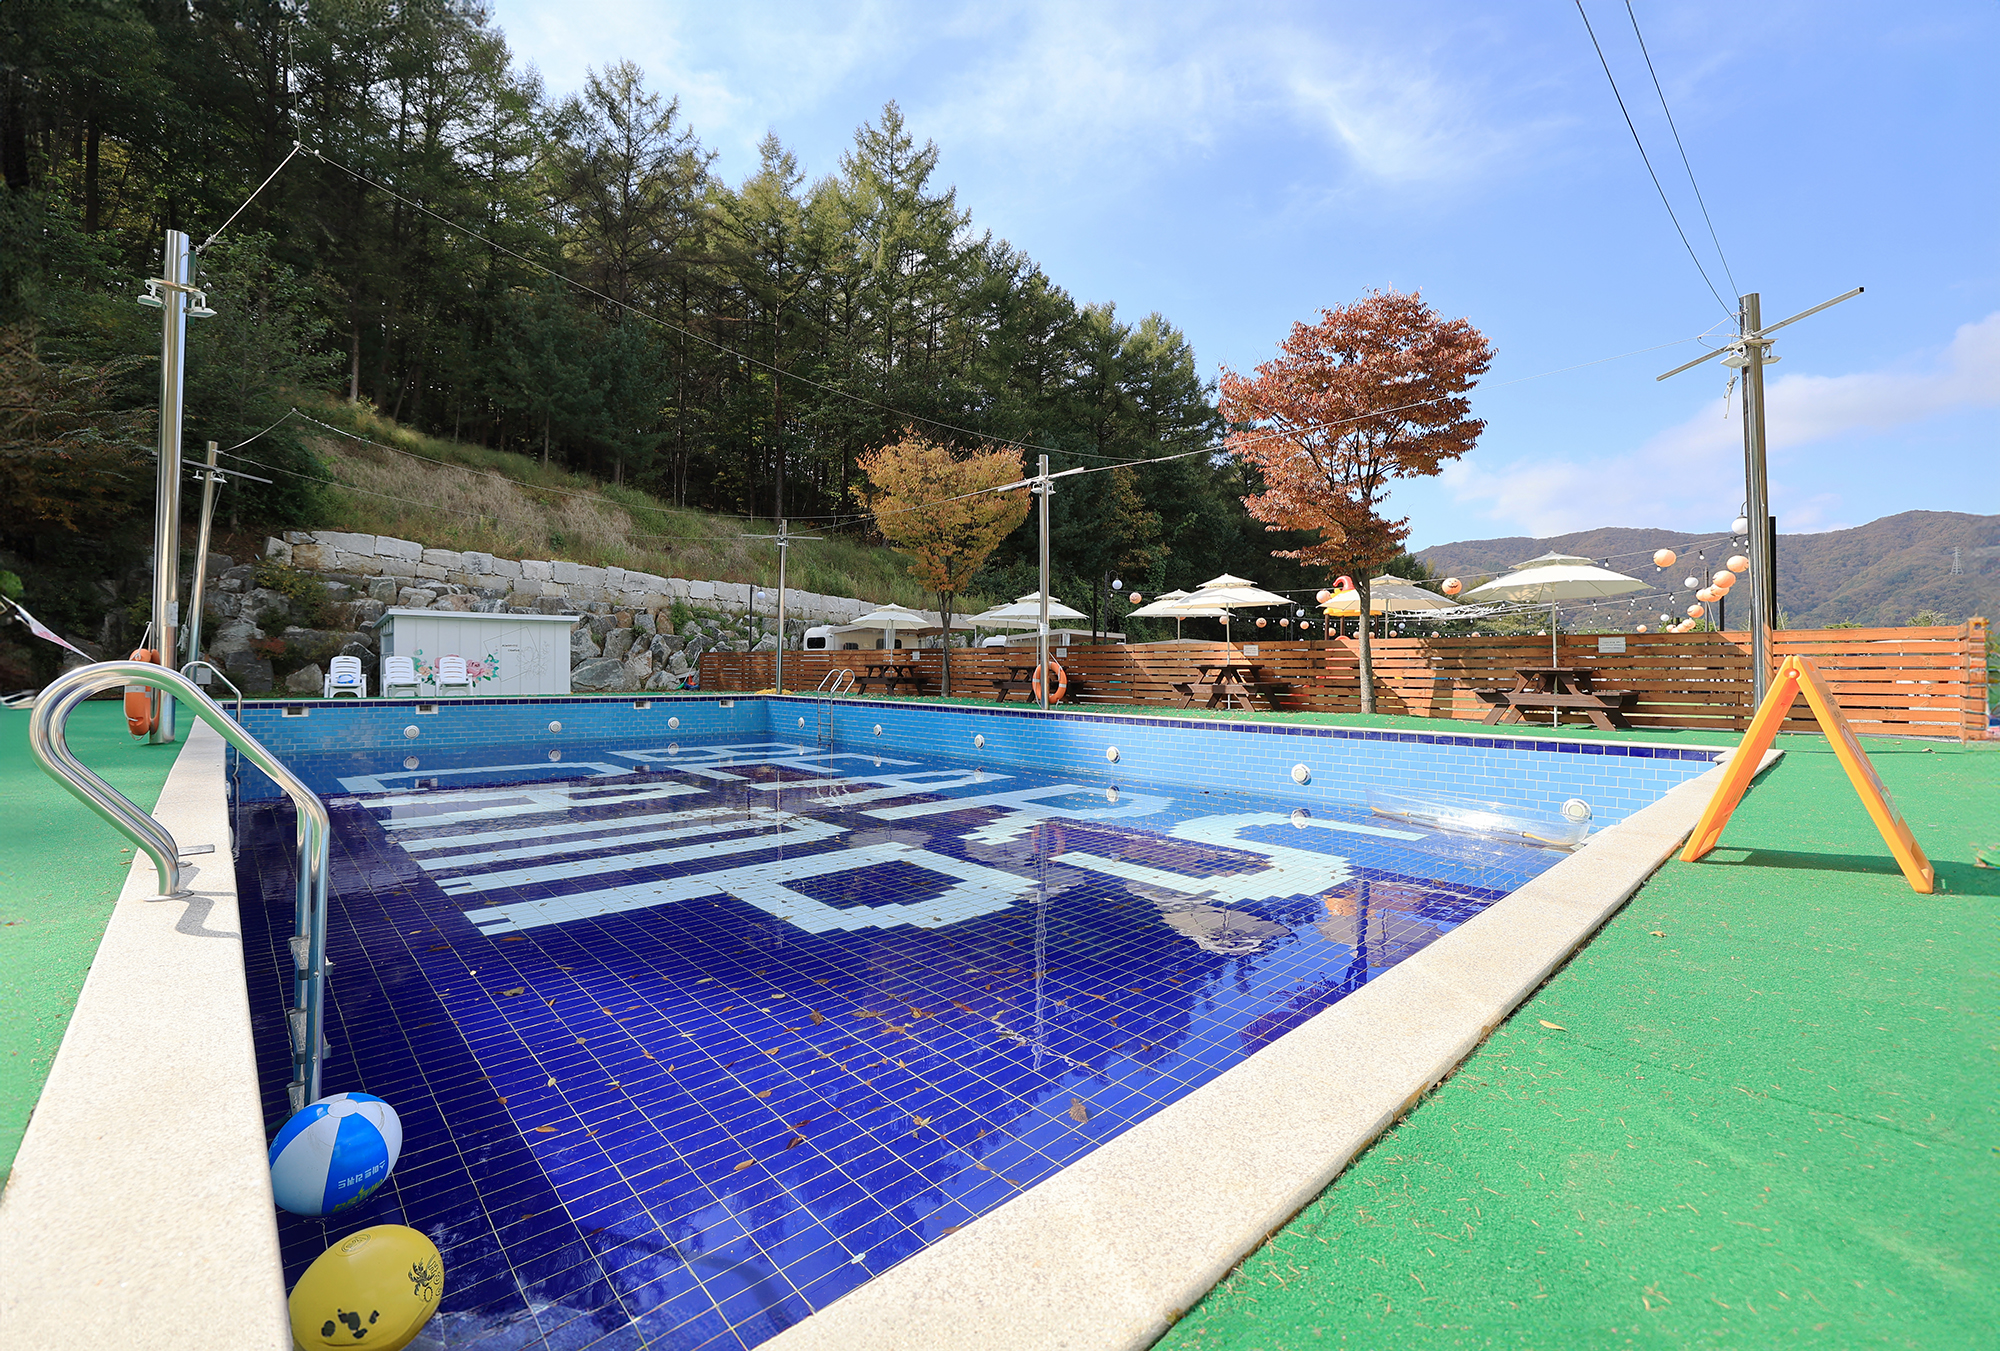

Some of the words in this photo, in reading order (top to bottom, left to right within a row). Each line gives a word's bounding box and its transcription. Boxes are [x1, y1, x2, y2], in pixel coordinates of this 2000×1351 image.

[336, 760, 1041, 937] CAMP
[608, 742, 1429, 904] BEARS
[365, 1159, 386, 1179] 스마트
